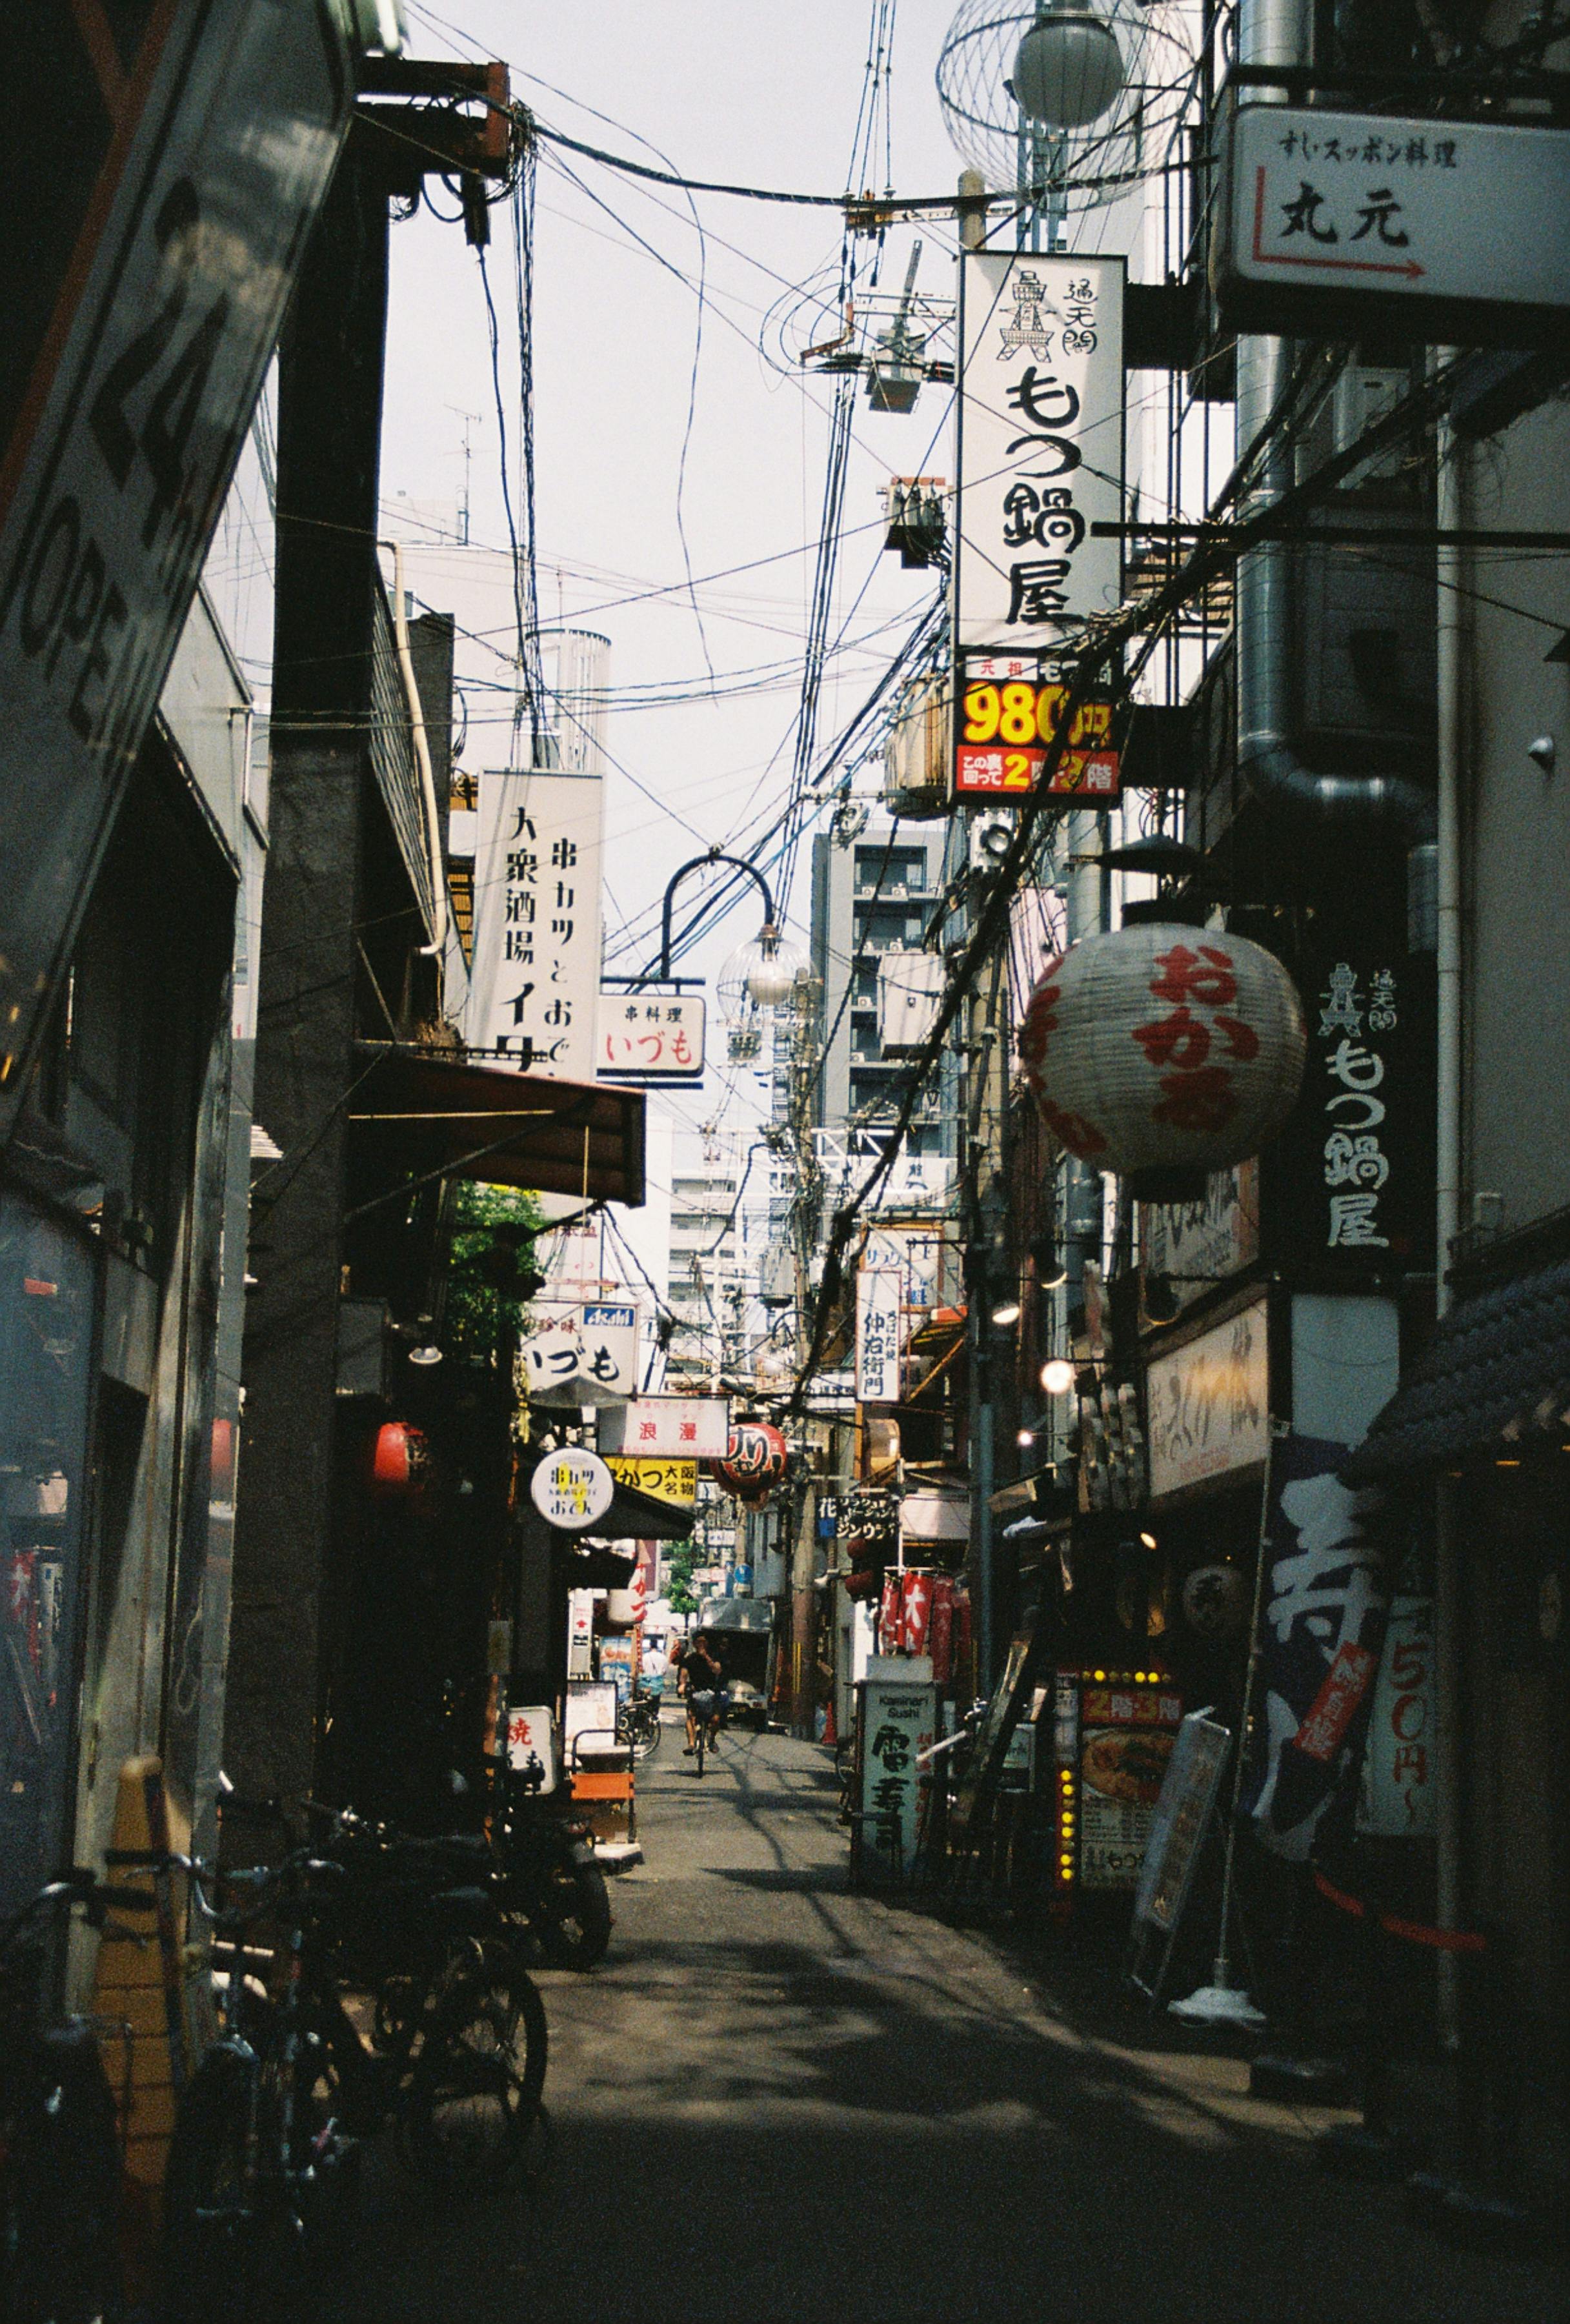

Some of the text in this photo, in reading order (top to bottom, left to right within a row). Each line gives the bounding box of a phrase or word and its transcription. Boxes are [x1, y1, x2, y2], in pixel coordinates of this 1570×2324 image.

[1278, 181, 1409, 248] 丸元
[1062, 278, 1098, 356] 通天閣
[1003, 365, 1089, 626] もつ鍋屋
[980, 658, 1023, 676] 元祖
[963, 680, 1112, 747] 980円
[503, 806, 538, 965] 大衆酒場
[543, 838, 577, 1077] 串カツとおで
[625, 1005, 683, 1023] 串料理
[607, 1029, 692, 1064] いづも
[1324, 1039, 1390, 1248] もつ鍋屋
[588, 1308, 630, 1326] Asahi
[639, 1422, 697, 1441] 浪漫
[612, 1467, 663, 1489] かつ
[819, 1497, 837, 1518] 花
[879, 1695, 929, 1706] Kaminari
[887, 1707, 920, 1719] Sushi
